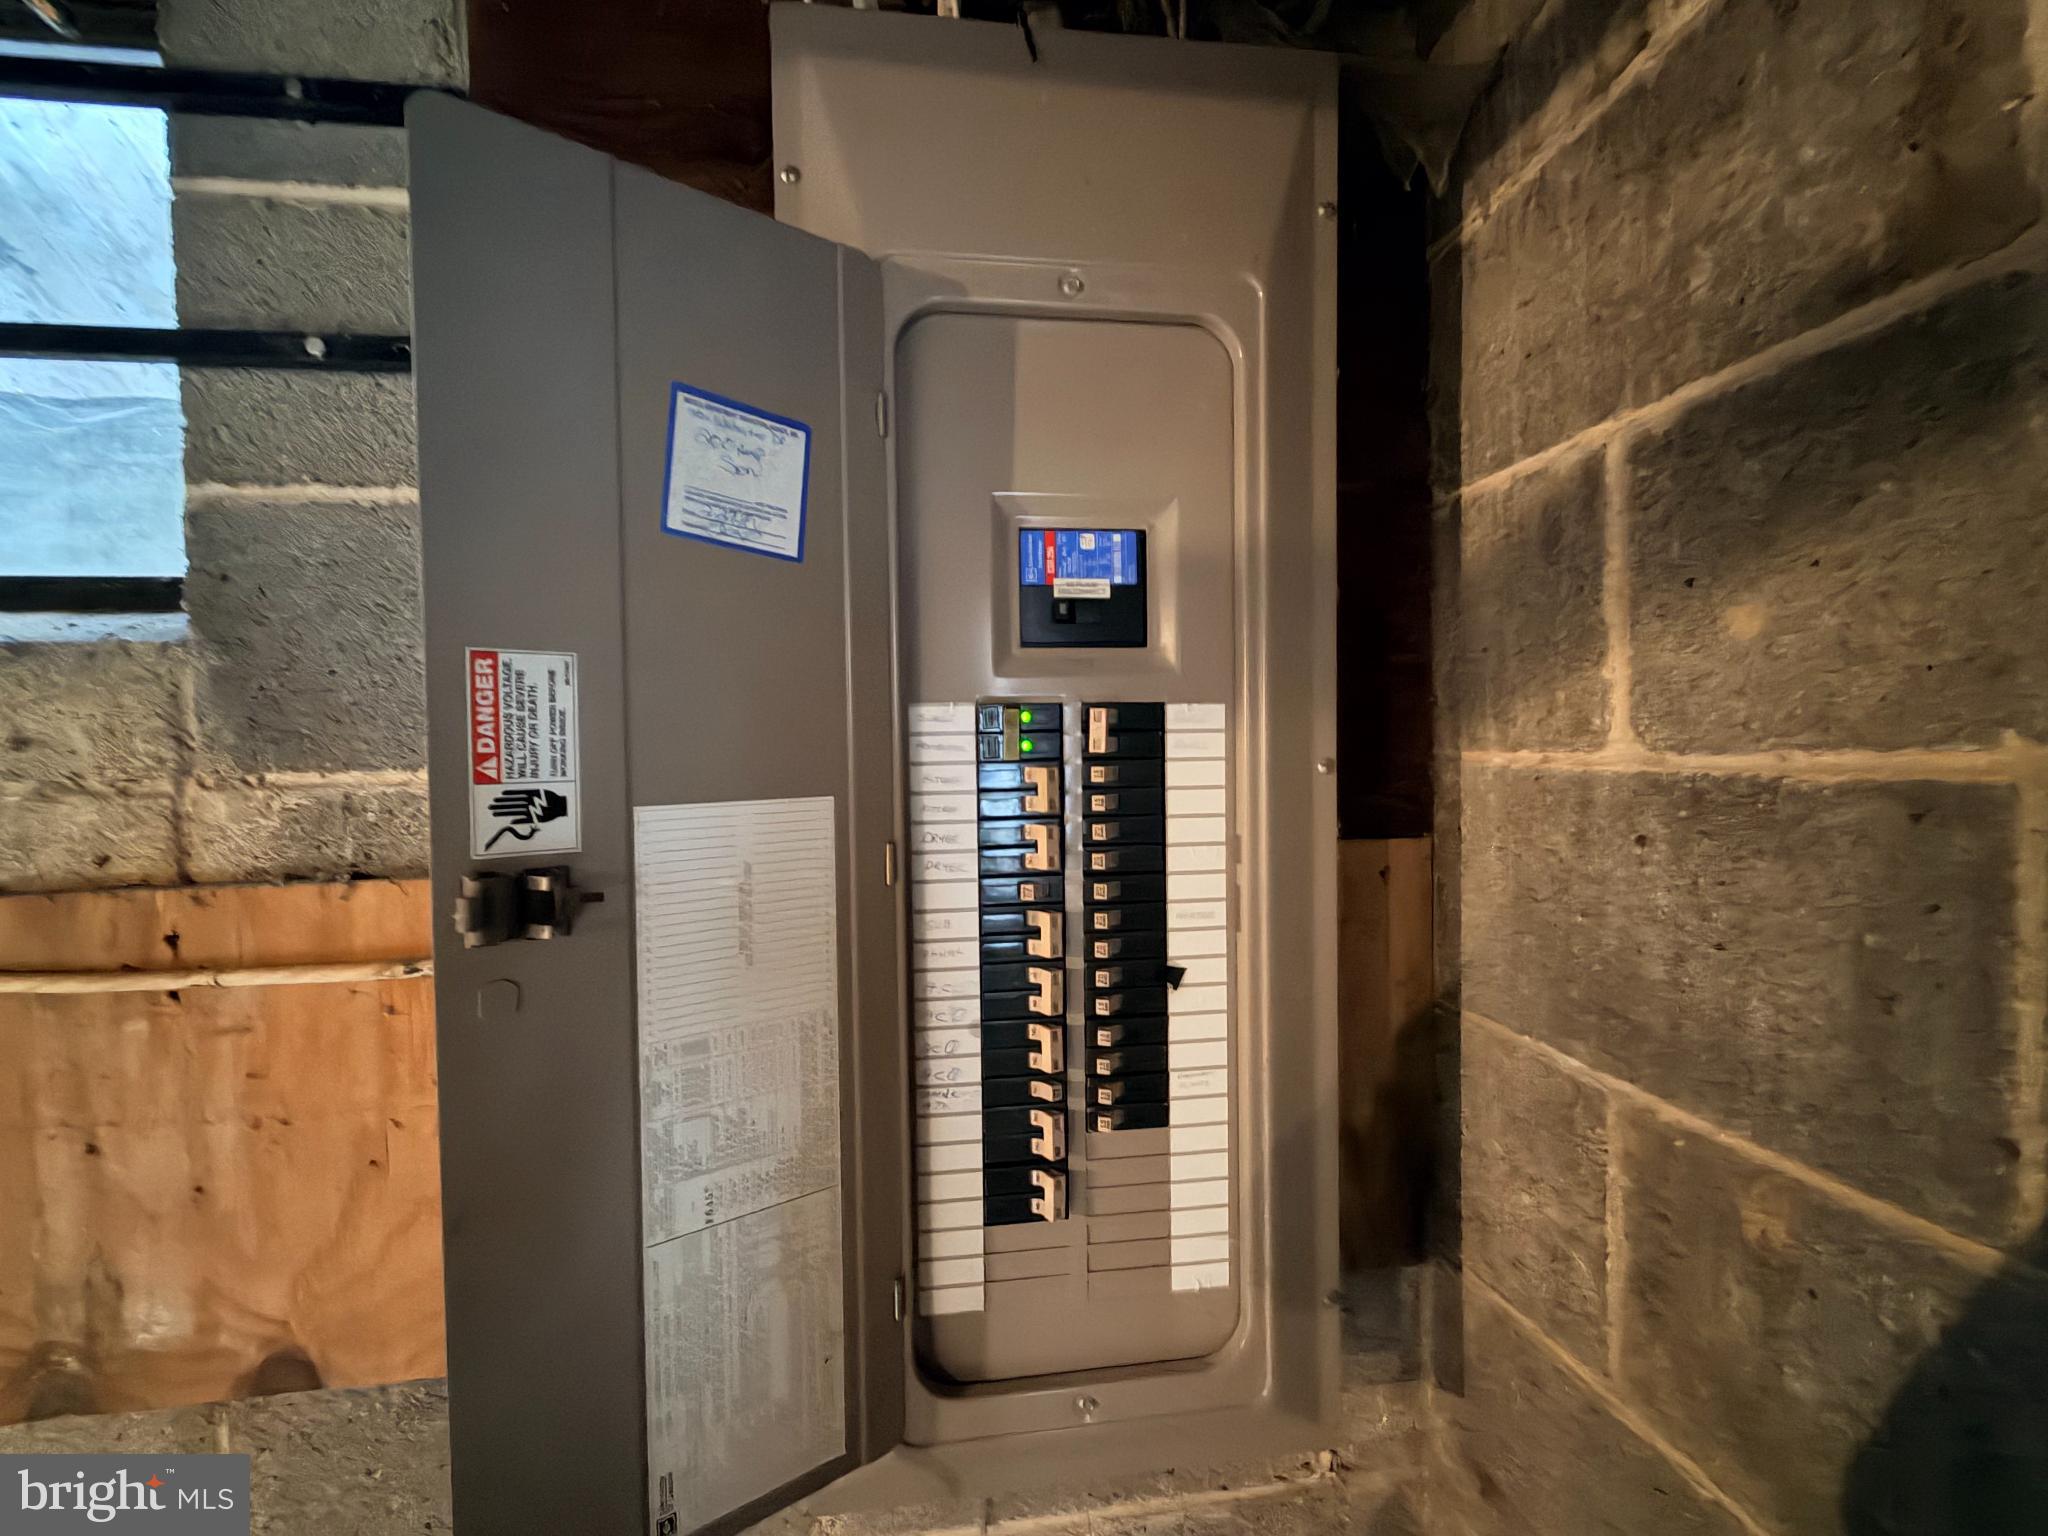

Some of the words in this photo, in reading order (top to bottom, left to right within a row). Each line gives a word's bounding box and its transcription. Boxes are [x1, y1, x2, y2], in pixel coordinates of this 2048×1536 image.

[475, 658, 496, 753] DANGER
[515, 669, 526, 712] SEVERE
[503, 713, 516, 779] HAZARDOUS
[516, 714, 527, 751] CAUSE
[528, 723, 540, 739] OR
[516, 757, 527, 778] WILL
[529, 741, 540, 778] INJURY
